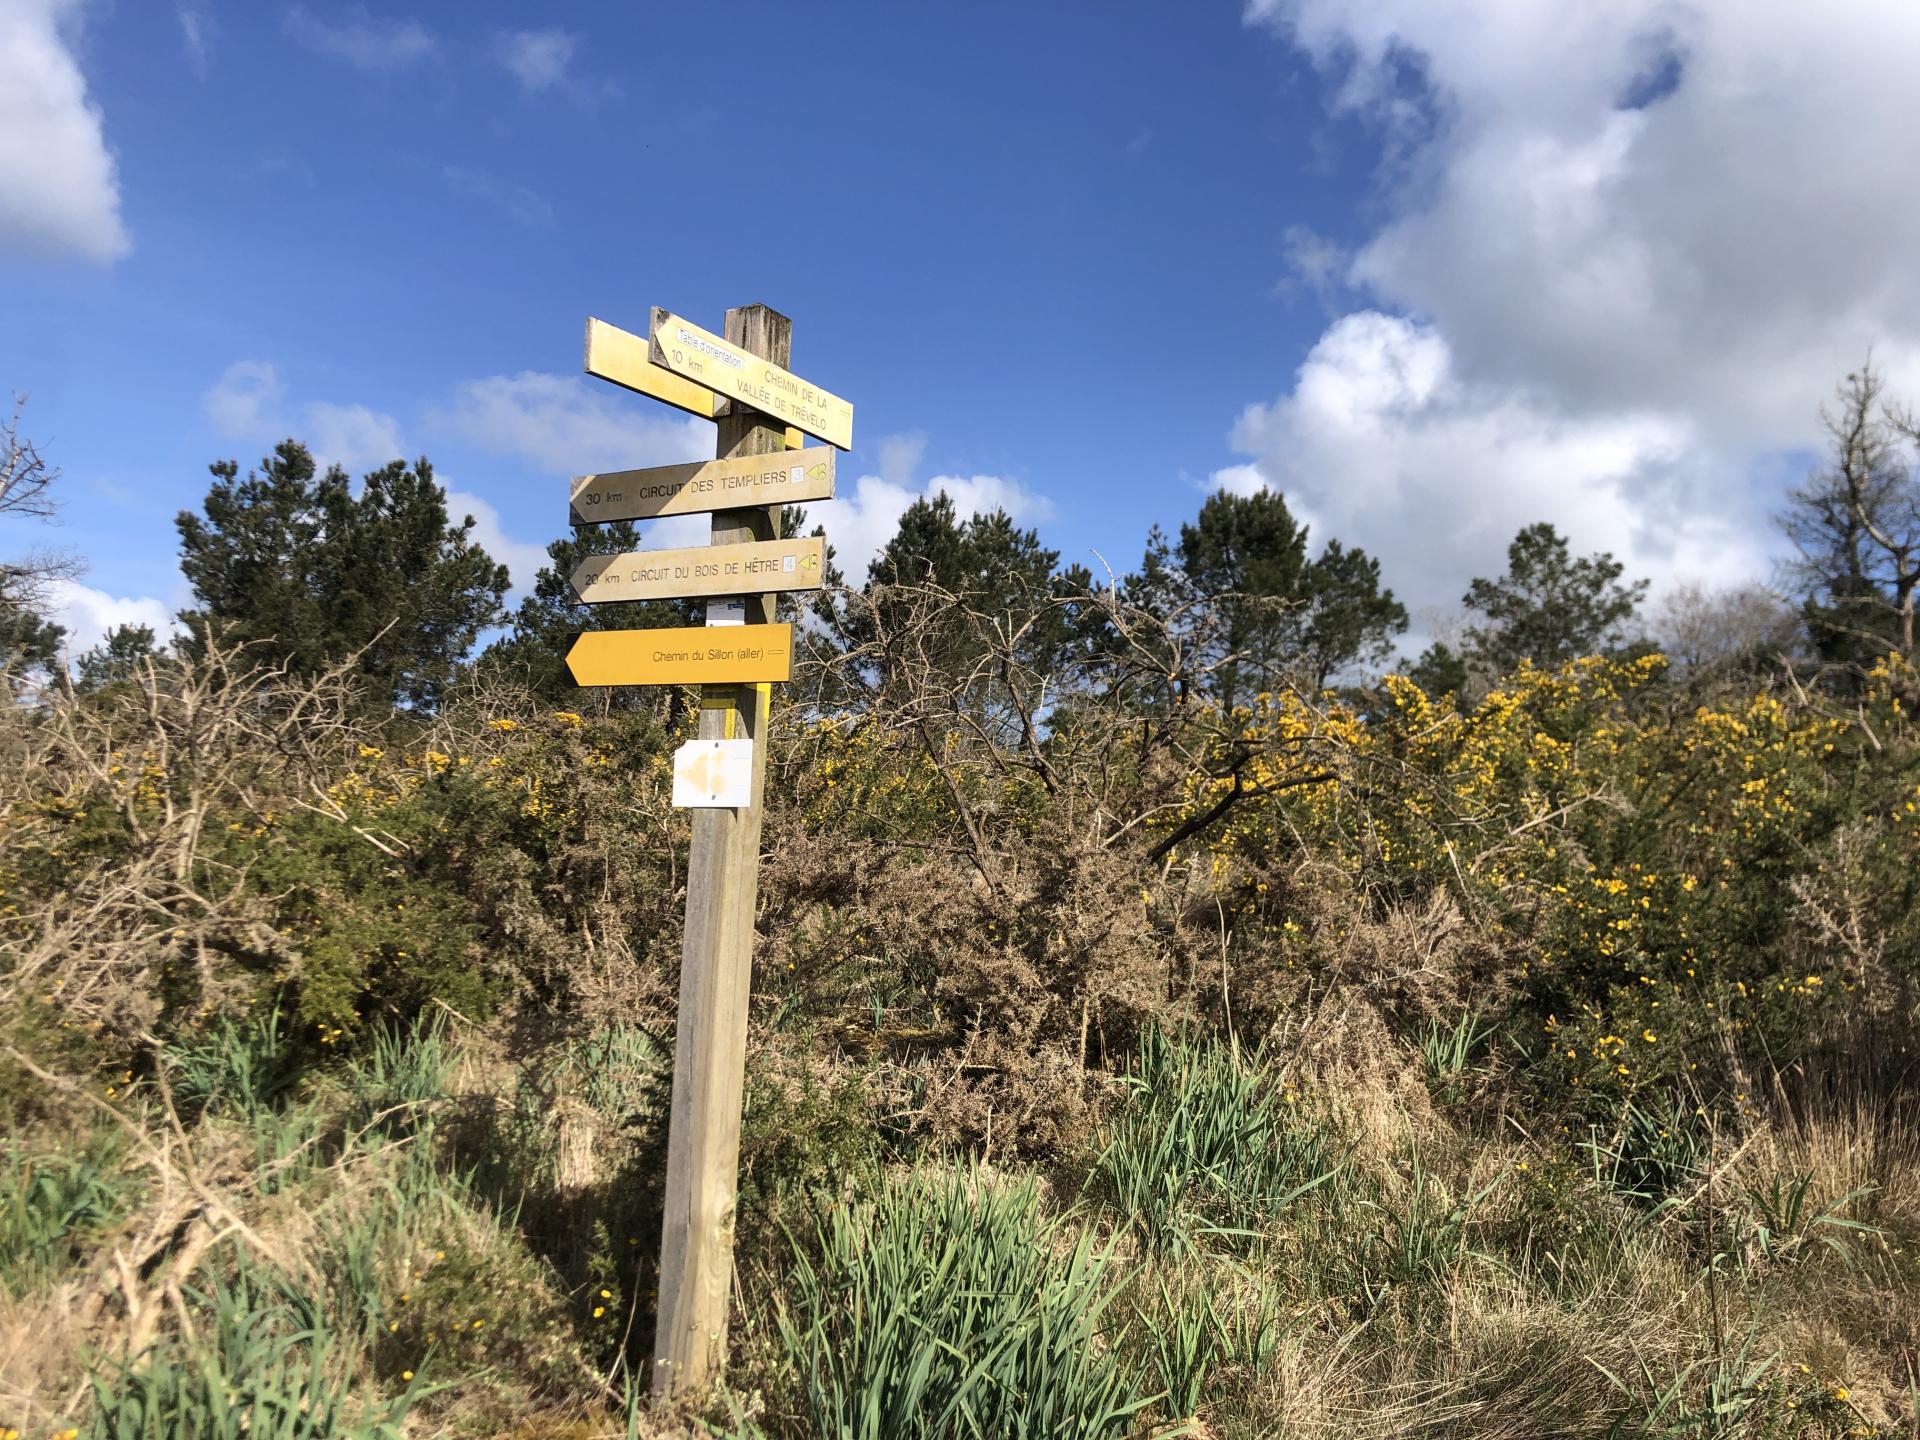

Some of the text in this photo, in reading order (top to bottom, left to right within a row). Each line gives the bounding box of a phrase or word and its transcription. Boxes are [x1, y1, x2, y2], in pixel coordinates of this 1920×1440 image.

[679, 329, 699, 348] Table
[672, 349, 703, 373] 10 km
[737, 378, 827, 431] VALLÉE DE TRÉVELO
[764, 370, 827, 410] CHEMIN DE LA
[585, 493, 601, 506] 30
[606, 492, 622, 503] km
[639, 482, 684, 500] CIRCUIT
[691, 479, 714, 493] DES
[721, 470, 787, 490] TEMPLIERS
[585, 573, 599, 586] 20
[604, 574, 620, 584] km
[631, 567, 669, 583] CIRCUIT
[675, 566, 689, 579] DU
[694, 564, 719, 577] BOIS
[724, 562, 739, 575] DE
[744, 557, 779, 574] HÊTRE
[652, 647, 764, 662] Chemin du Sillon (aller)
